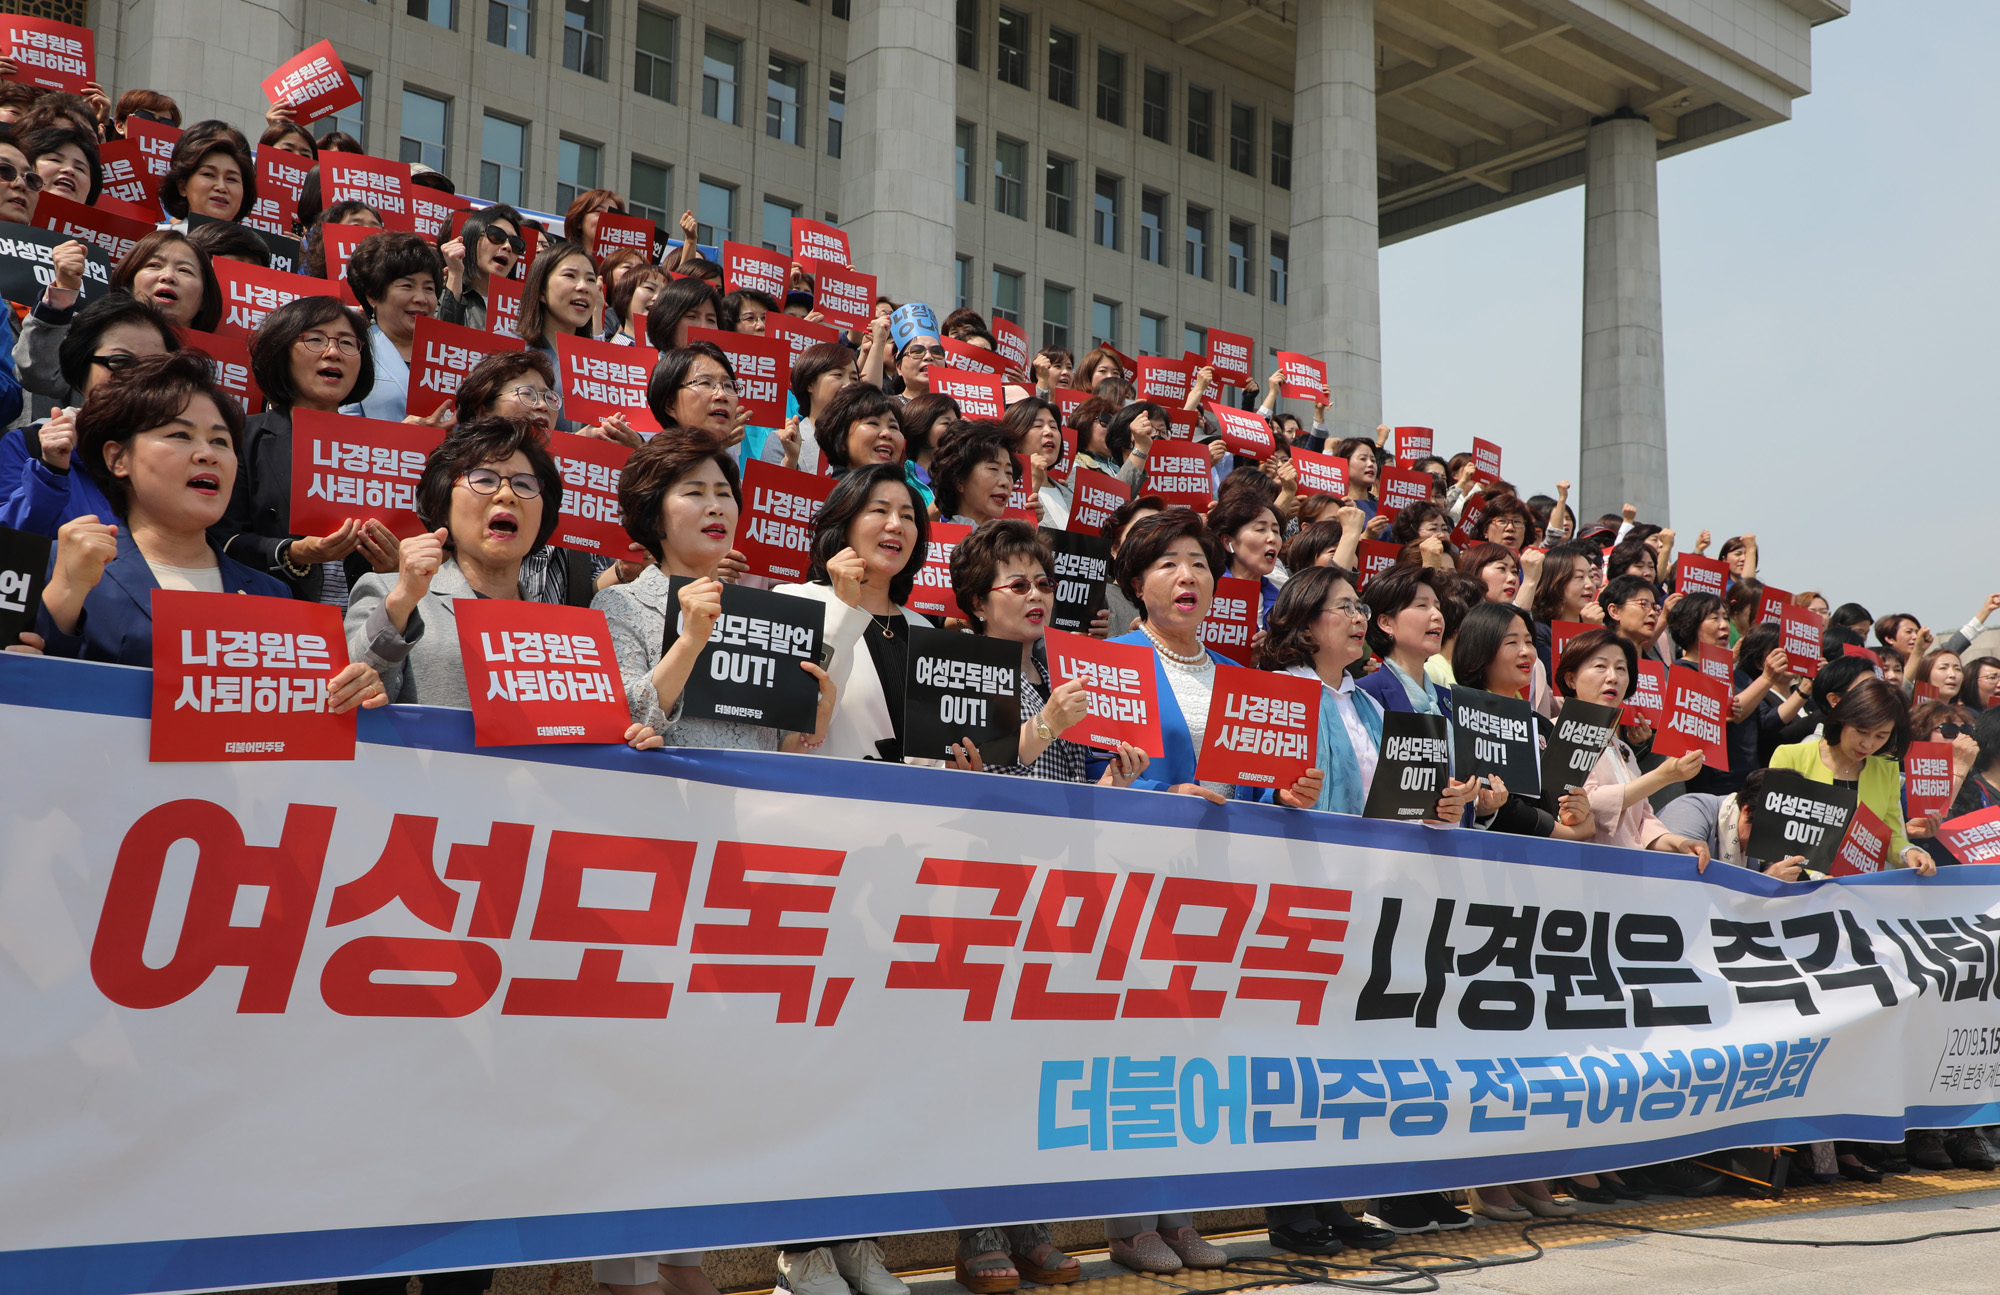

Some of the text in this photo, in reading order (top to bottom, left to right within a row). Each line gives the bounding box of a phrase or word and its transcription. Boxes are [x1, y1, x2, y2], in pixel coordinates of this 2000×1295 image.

[10, 28, 83, 57] 나경원은
[9, 46, 87, 77] 사퇴하라!
[274, 56, 332, 97] 나경원은
[140, 136, 175, 158] 나경
[269, 162, 305, 186] 나경
[332, 167, 401, 195] 나경원은
[600, 227, 647, 247] 나경원은
[800, 230, 844, 252] 나경원은
[799, 245, 848, 267] 사퇴하라!
[732, 256, 784, 282] 나경원은
[230, 281, 303, 310] 나경원
[730, 272, 784, 300] 사퇴하라!
[821, 276, 868, 301] 나경원은
[819, 293, 870, 318] 사퇴하라!
[998, 329, 1027, 353] 나경원은
[1213, 341, 1248, 360] 나경원은
[426, 341, 484, 372] 나경원
[1212, 355, 1248, 374] 사퇴하라!
[571, 355, 647, 387] 나경원은
[1145, 369, 1186, 385] 나경원은
[1285, 362, 1321, 378] 나경원은
[571, 378, 651, 409] 사퇴하라
[738, 378, 777, 402] 하라!
[938, 381, 993, 401] 나경원은
[1143, 383, 1186, 400] 사퇴하라!
[958, 399, 998, 417] 퇴하라!
[1221, 412, 1265, 432] 나경원은
[1226, 424, 1270, 446] 사퇴하라!
[1401, 436, 1431, 450] 나경원은
[313, 439, 426, 480] 나경원은
[1150, 456, 1206, 475] 나경원은
[1475, 459, 1499, 478] 사퇴하라!
[1476, 447, 1499, 465] 나경원은
[1298, 459, 1342, 480] 나경원은
[307, 473, 416, 512] 사퇴하라
[1147, 475, 1209, 494] 사퇴하라!
[1298, 474, 1345, 496] 사퇴하라!
[1387, 479, 1426, 498] 나경원은
[1081, 486, 1125, 511] 나경원은
[563, 534, 600, 549] 더불어민주당
[769, 564, 800, 578] 더불어민주당
[1052, 551, 1107, 581] 성모독발언
[1684, 565, 1722, 586] 나경원은
[1056, 579, 1090, 605] OUT!
[914, 601, 945, 612] 더불어민주당
[676, 609, 814, 659] 모독발언
[1786, 619, 1820, 643] 나경원은
[181, 629, 331, 670] 나경원은
[481, 631, 601, 666] 나경원은
[1783, 637, 1821, 660] 사퇴하라!
[710, 650, 775, 688] OUT!
[916, 656, 1014, 696] 여성모독발언
[1058, 655, 1141, 694] 나경원은
[1702, 658, 1729, 679] 나경원은
[174, 675, 338, 714] 사퇴하라
[486, 670, 616, 703] 사퇴하라!
[715, 704, 763, 719] 더불어민주당
[940, 694, 987, 727] OUT!
[1086, 690, 1147, 725] 퇴하라!
[1224, 693, 1306, 729] 나경원은
[1623, 689, 1663, 710] 퇴하라!
[1675, 687, 1721, 721] 나경원은
[536, 726, 586, 737] 더불어민주당
[1458, 706, 1528, 743] 여성모독발언
[1668, 711, 1721, 745] 사퇴하라!
[225, 741, 285, 753] 더불어민주당
[1090, 733, 1121, 747] 더불어민주당
[1214, 725, 1308, 760] 사퇴하라!
[1385, 736, 1448, 763] 여성모독발언
[1474, 737, 1507, 765] OUT!
[1237, 771, 1275, 784] 더불어민주당
[1400, 766, 1436, 791] OUT!
[1910, 758, 1949, 777] 나경원은
[1911, 778, 1950, 797] 사퇴하라!
[1397, 807, 1425, 816] 더불어민주당
[1765, 791, 1849, 828] 여성모독발언
[1784, 820, 1825, 847] OUT!
[1850, 820, 1884, 859] 나경원은
[90, 798, 855, 1028] 여성모독,
[885, 857, 1353, 1026] 국민모독
[1355, 897, 1712, 1031] 나경원은
[1711, 909, 1898, 1016] 즉각
[1940, 1063, 1963, 1092] 국회
[1963, 1064, 1986, 1090] 본청
[1038, 1037, 1831, 1151] 더불어민주당 전국여성위원회
